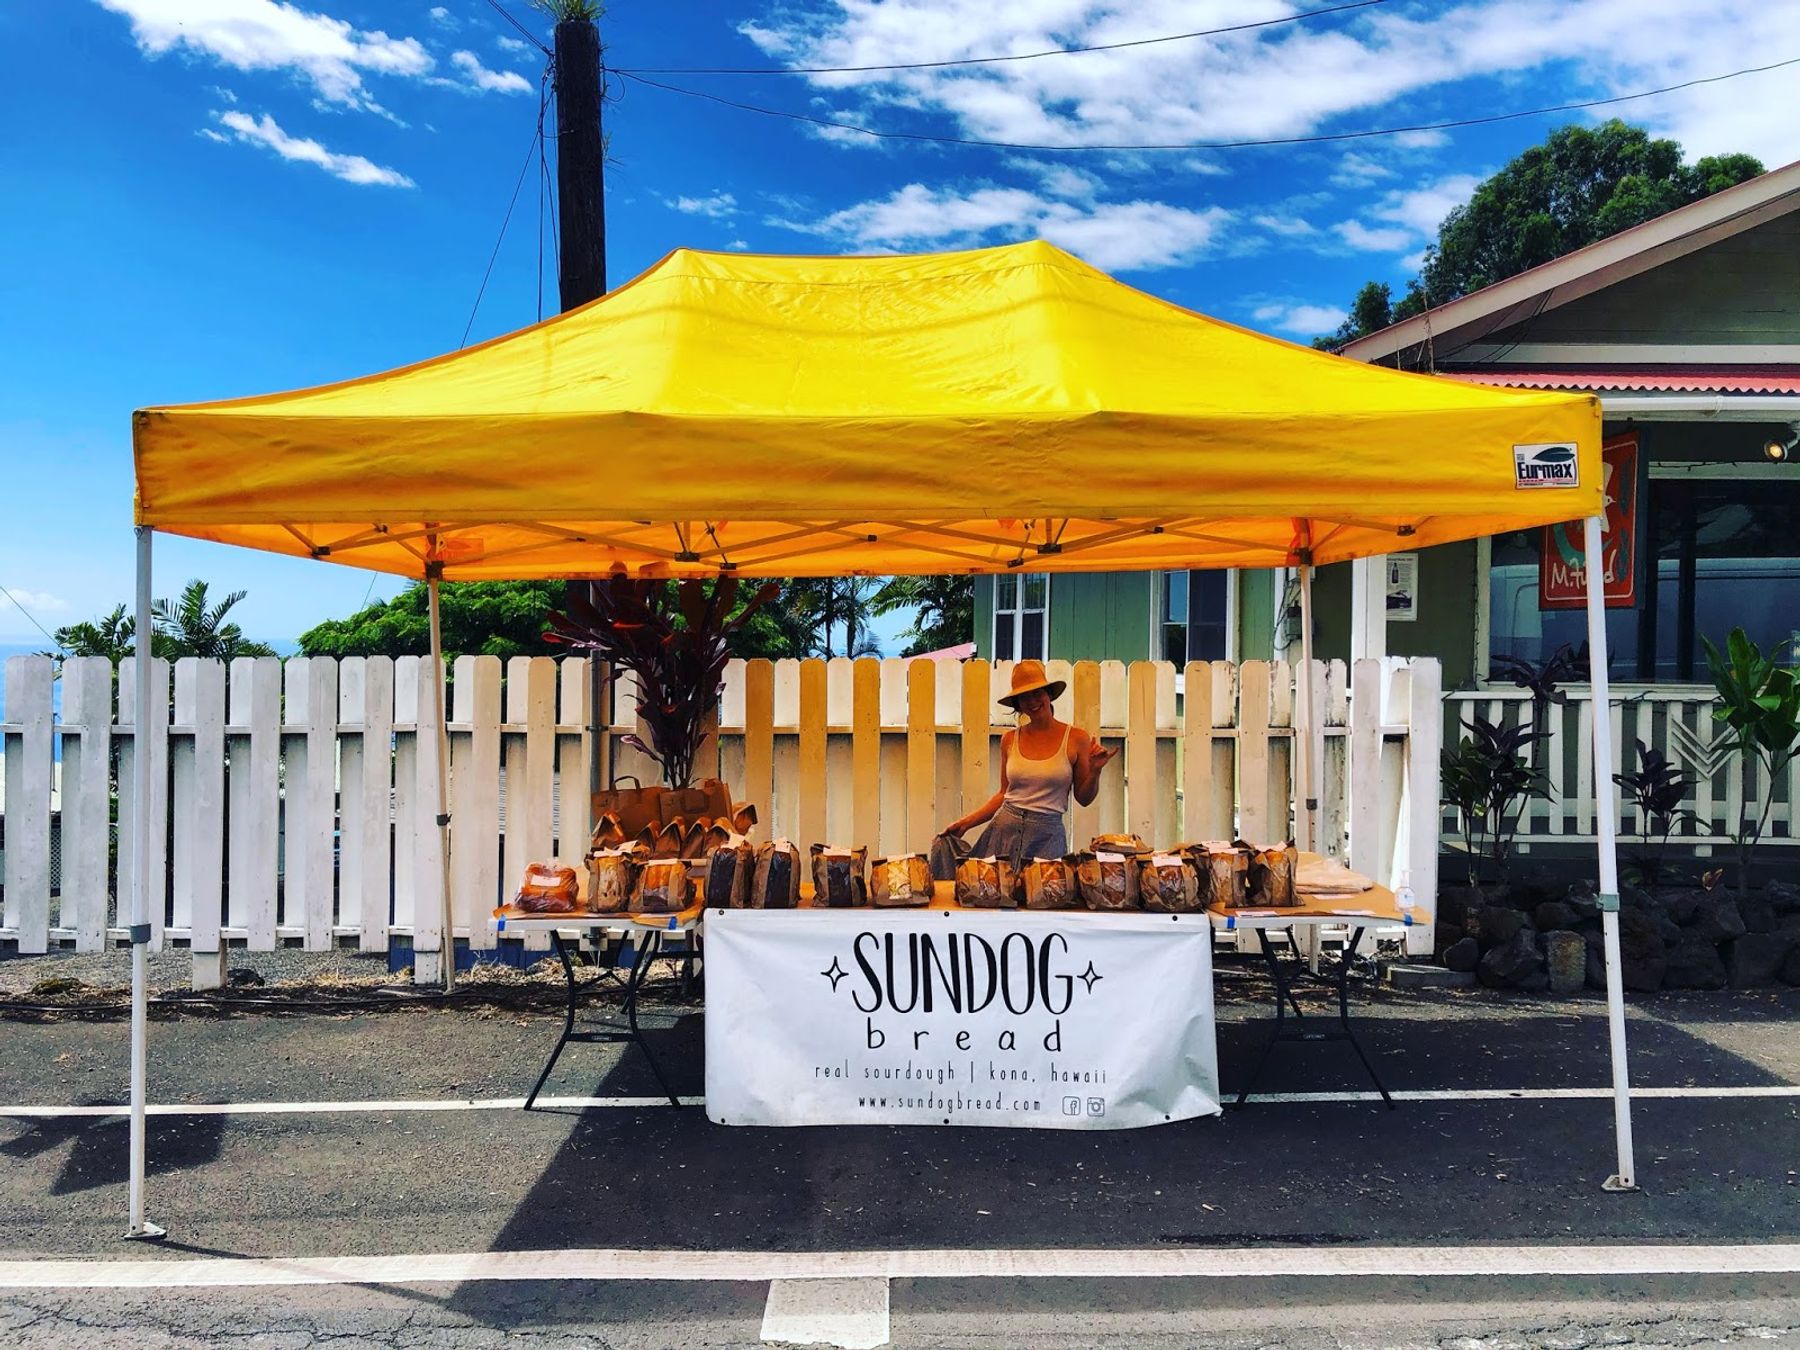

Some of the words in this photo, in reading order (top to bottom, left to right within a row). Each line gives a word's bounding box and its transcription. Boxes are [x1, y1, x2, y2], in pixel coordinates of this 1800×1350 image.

[1517, 462, 1573, 479] Eurmax
[852, 931, 1073, 1015] SUNDOG
[867, 1017, 1062, 1052] bread
[815, 1059, 849, 1079] real
[864, 1060, 955, 1085] sourdough
[1051, 1062, 1106, 1084] hawaii
[858, 1091, 1041, 1114] www.sundogbread.com
